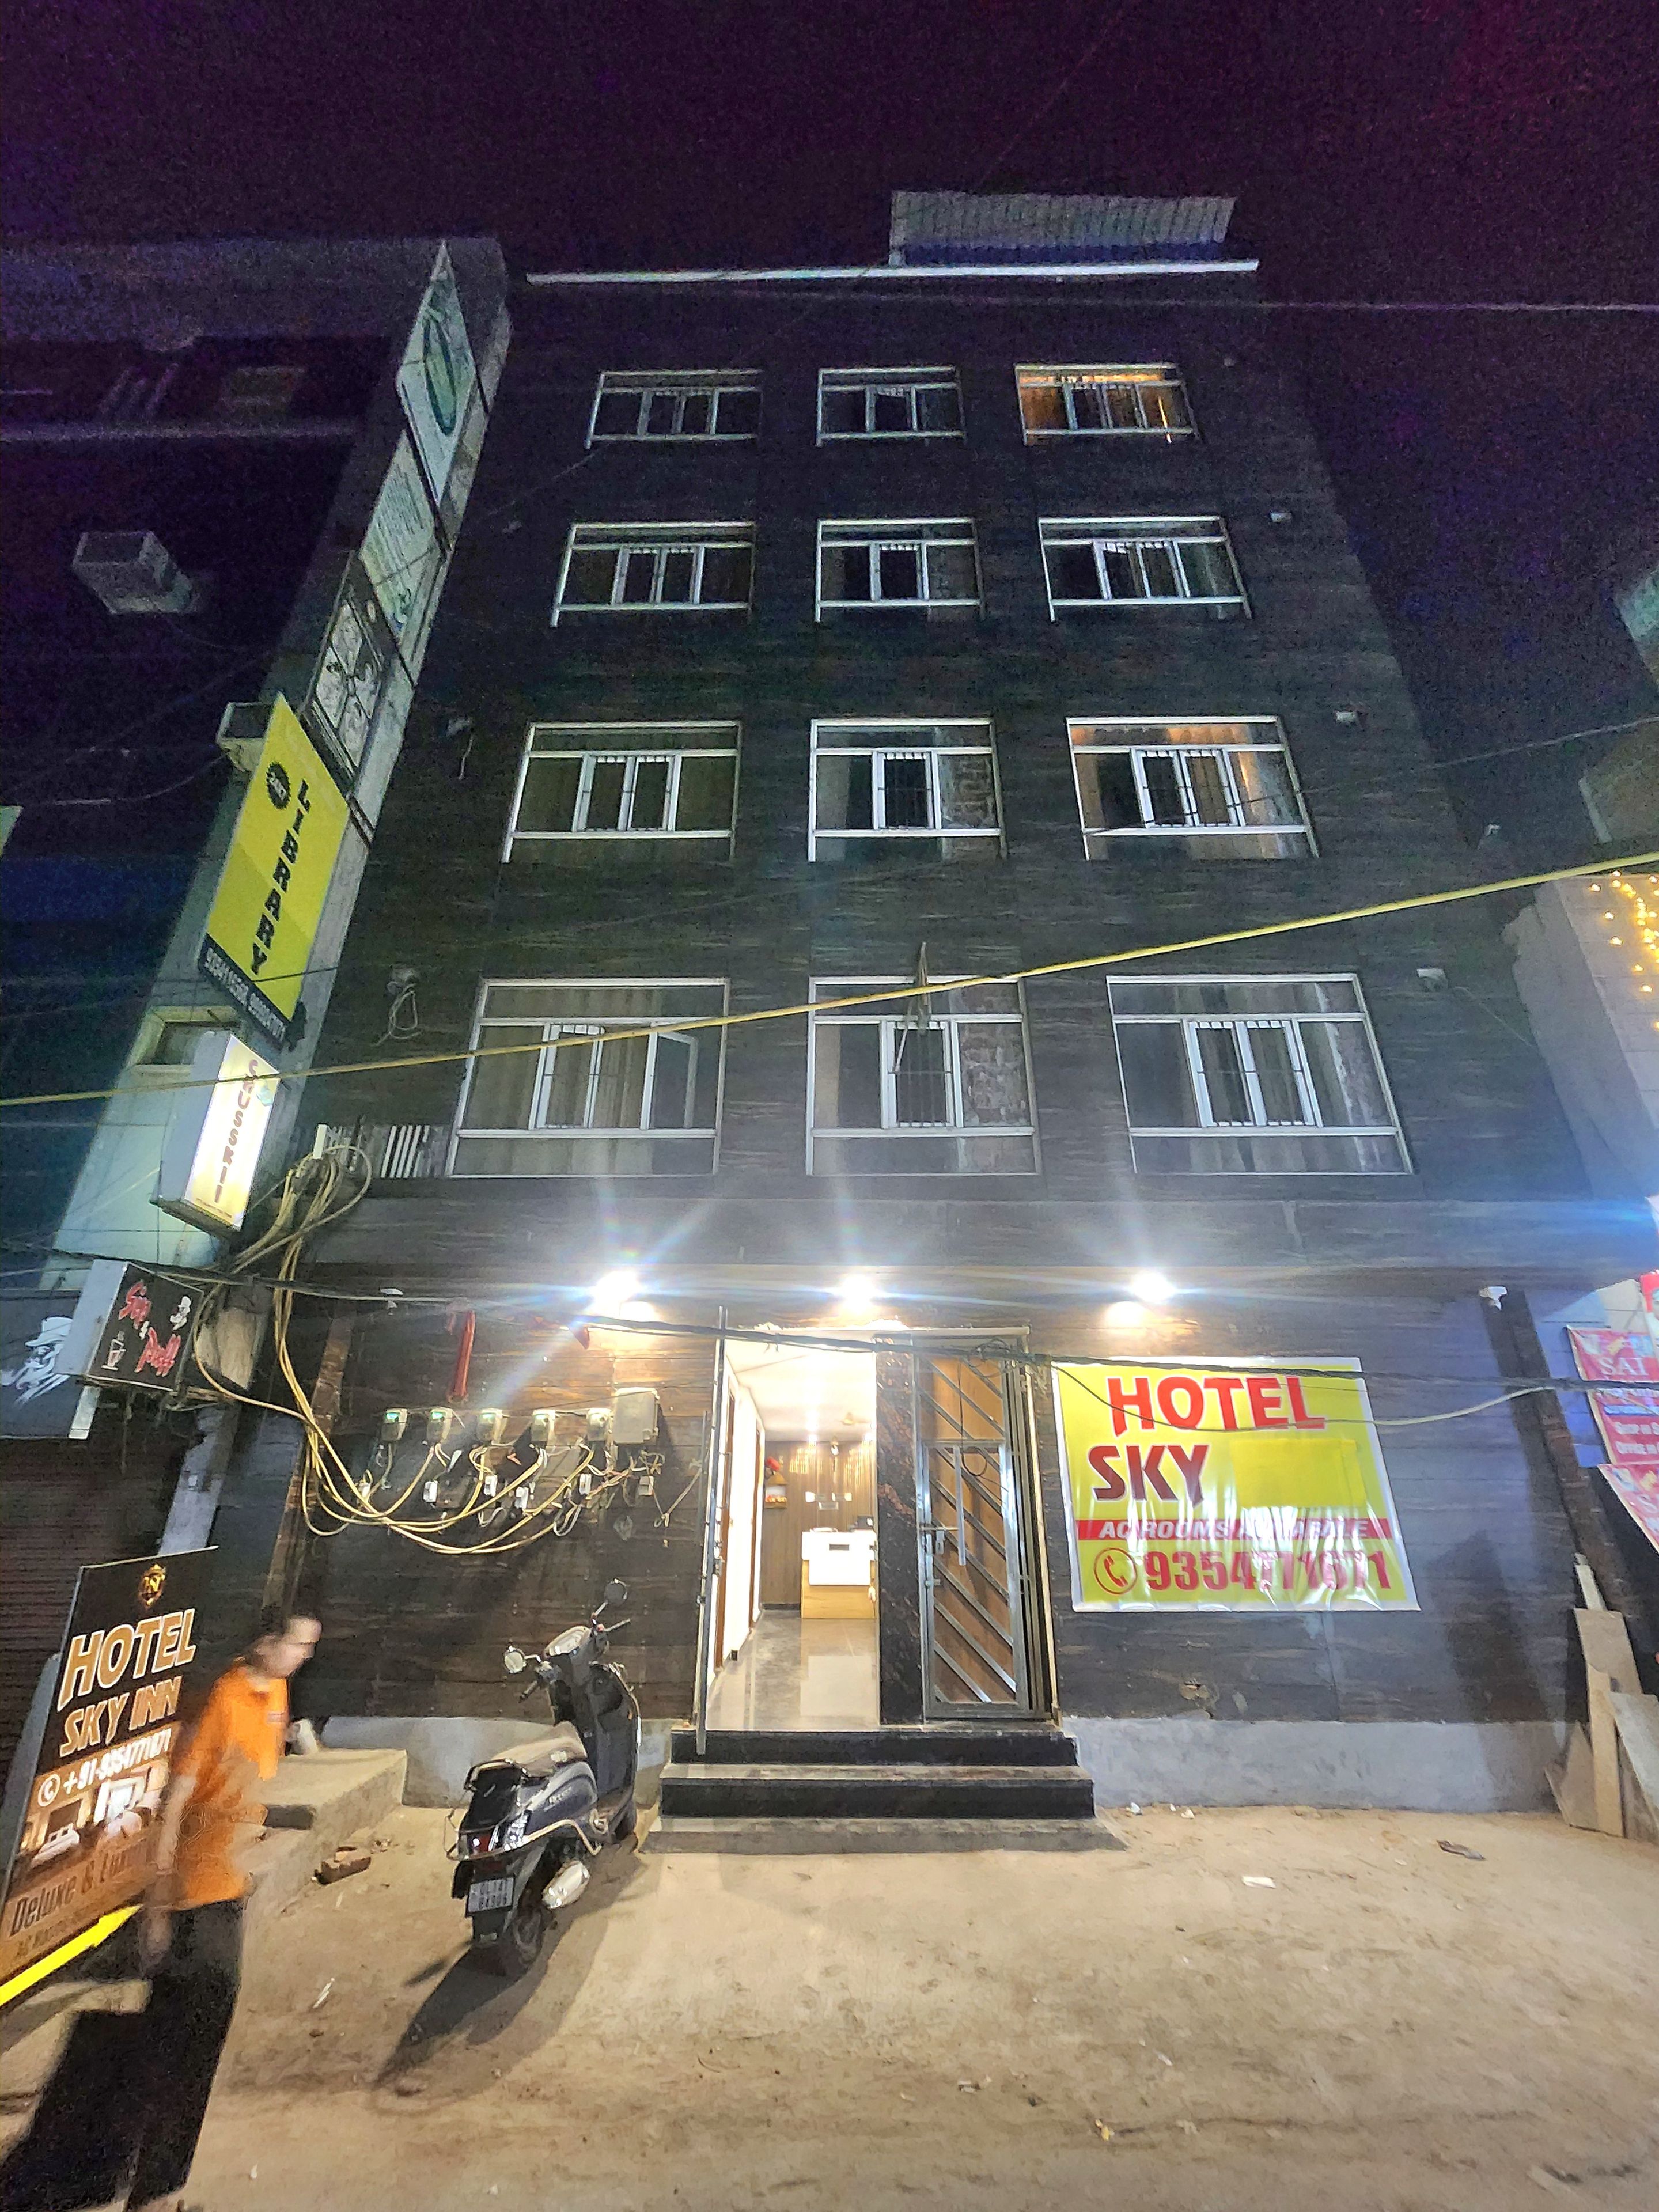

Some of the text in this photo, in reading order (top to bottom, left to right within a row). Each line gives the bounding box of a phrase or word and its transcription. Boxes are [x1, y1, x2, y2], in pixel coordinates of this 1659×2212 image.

[251, 778, 311, 975] LIBRARY
[1599, 1357, 1649, 1376] SAI
[1107, 1376, 1325, 1438] HOTEL
[1088, 1444, 1210, 1508] SKY
[58, 1608, 196, 1712] HOTEL
[59, 1676, 182, 1757] SKY INN
[9, 1876, 77, 1937] Deluxe
